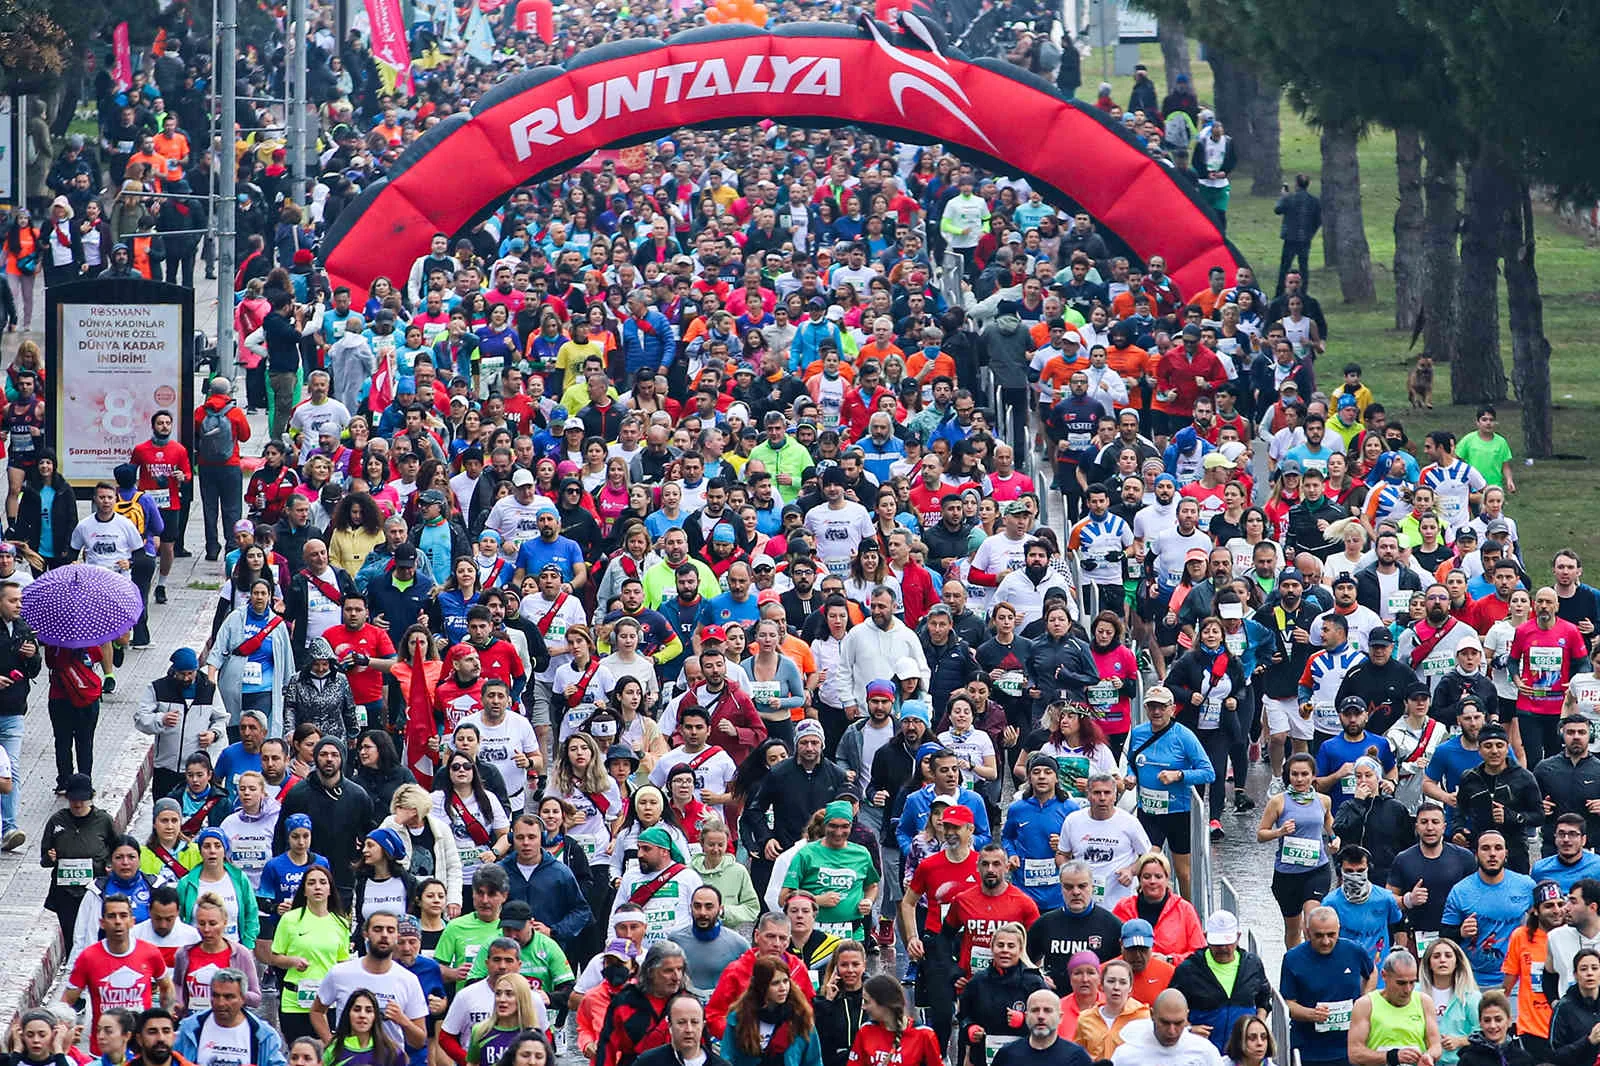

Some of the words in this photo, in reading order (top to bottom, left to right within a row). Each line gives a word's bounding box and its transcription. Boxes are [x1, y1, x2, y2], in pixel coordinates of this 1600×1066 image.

[509, 56, 842, 162] RUNTALYA
[79, 318, 113, 328] DÜNYA
[115, 320, 165, 329] KADINLAR
[132, 329, 157, 339] ÖZEL
[79, 339, 120, 350] DÜNYA
[123, 341, 165, 350] KADAR
[97, 352, 146, 363] İNDİRİM!
[102, 390, 133, 435] 8
[104, 436, 136, 445] MART
[69, 448, 111, 457] Şarampol
